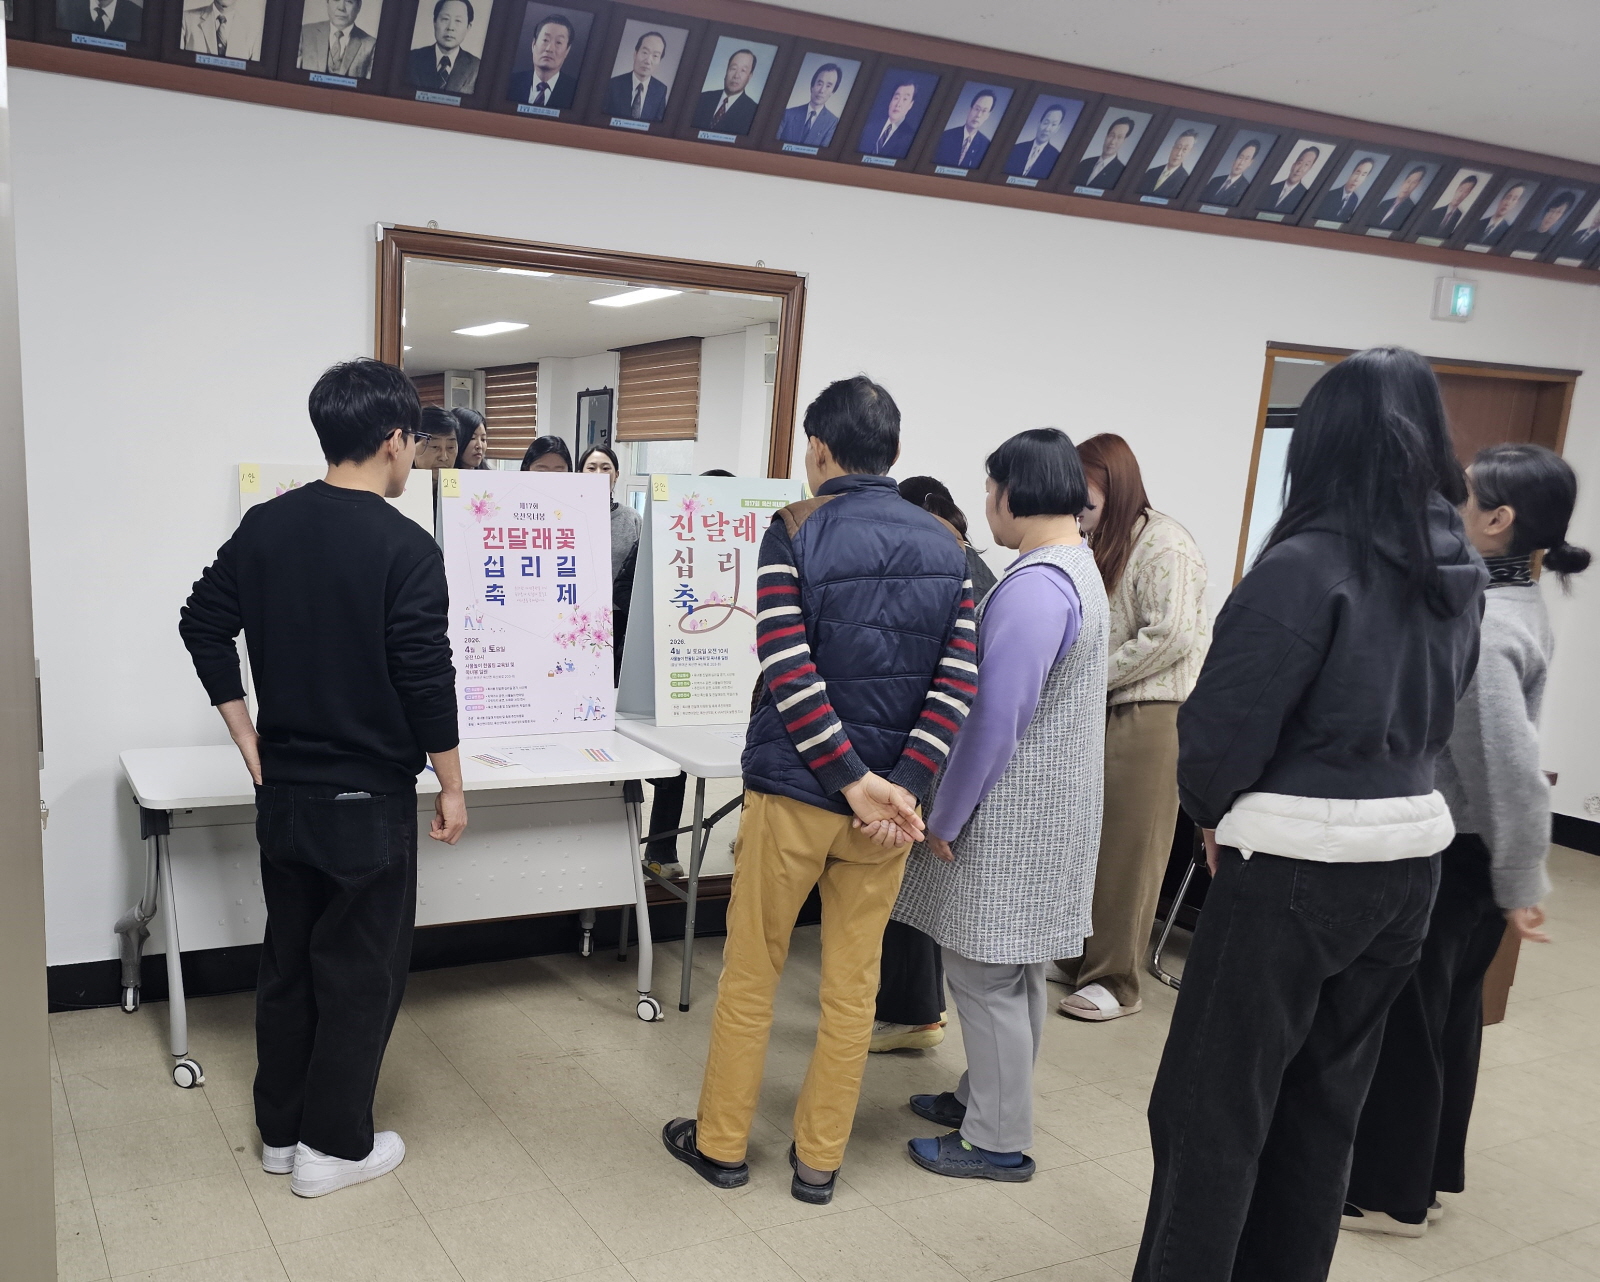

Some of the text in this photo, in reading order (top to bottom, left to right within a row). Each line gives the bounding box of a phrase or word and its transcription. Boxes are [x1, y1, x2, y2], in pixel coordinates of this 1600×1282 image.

[519, 502, 539, 510] 제17회
[482, 527, 576, 550] 진달래꽃
[488, 645, 506, 653] 토요일
[944, 1157, 984, 1169] crocs
